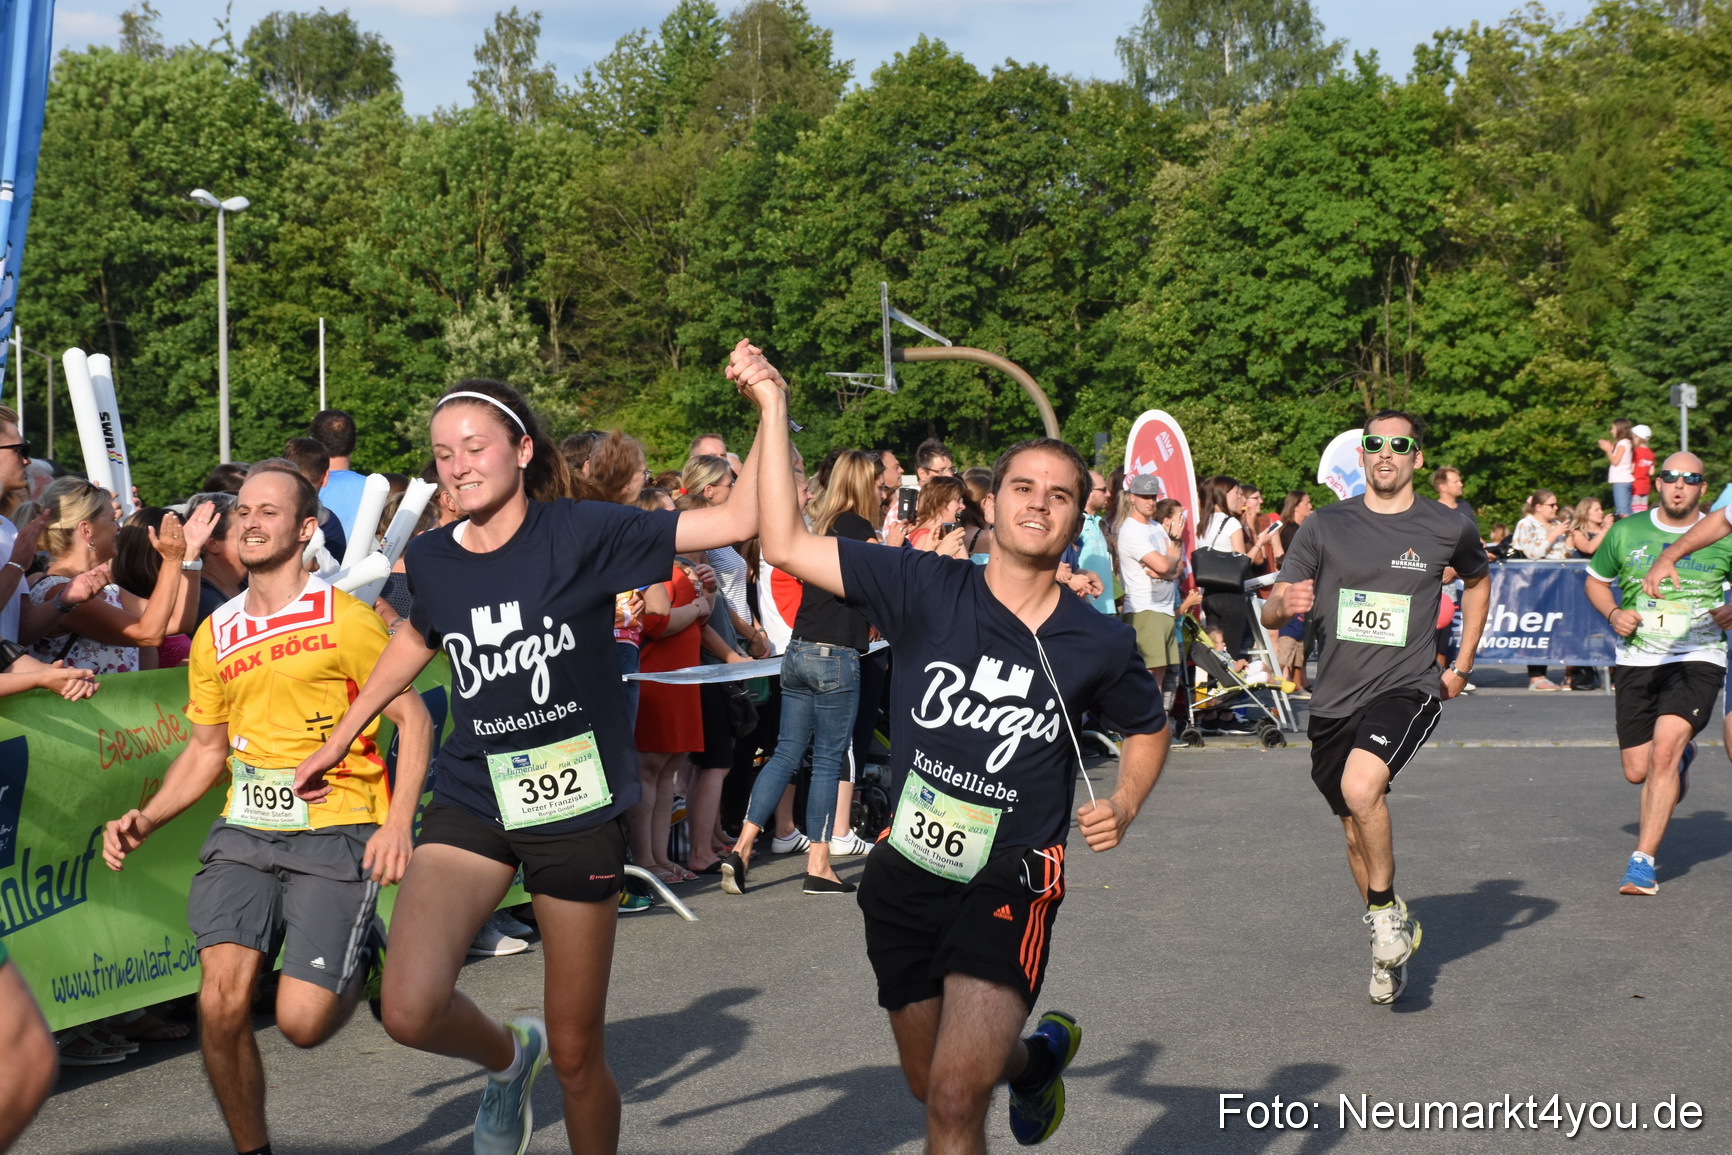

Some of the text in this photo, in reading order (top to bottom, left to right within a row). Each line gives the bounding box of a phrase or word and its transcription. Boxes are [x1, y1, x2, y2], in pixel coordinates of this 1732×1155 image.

[99, 411, 116, 449] swn
[1390, 559, 1428, 569] BURKHARDT
[1646, 554, 1717, 574] fienlauf
[1351, 609, 1392, 631] 405
[1657, 613, 1665, 628] 1
[219, 634, 338, 685] MAX BÖGL
[442, 615, 576, 705] Burgis
[473, 701, 583, 736] Knödelliebe.
[911, 661, 1060, 774] Burgis
[506, 760, 548, 776] firmenlauf
[573, 753, 593, 765] 2019
[518, 768, 582, 805] 392
[912, 748, 1020, 803] Knödelliebe.
[242, 782, 295, 811] 1699
[521, 792, 589, 814] Lerzer Franziska
[912, 793, 948, 819] firmenlauf
[909, 811, 967, 858] 396
[967, 827, 990, 836] 2019
[903, 834, 964, 869] Schmidt Thomas
[51, 935, 200, 1005] www.firmenlauf-ob
